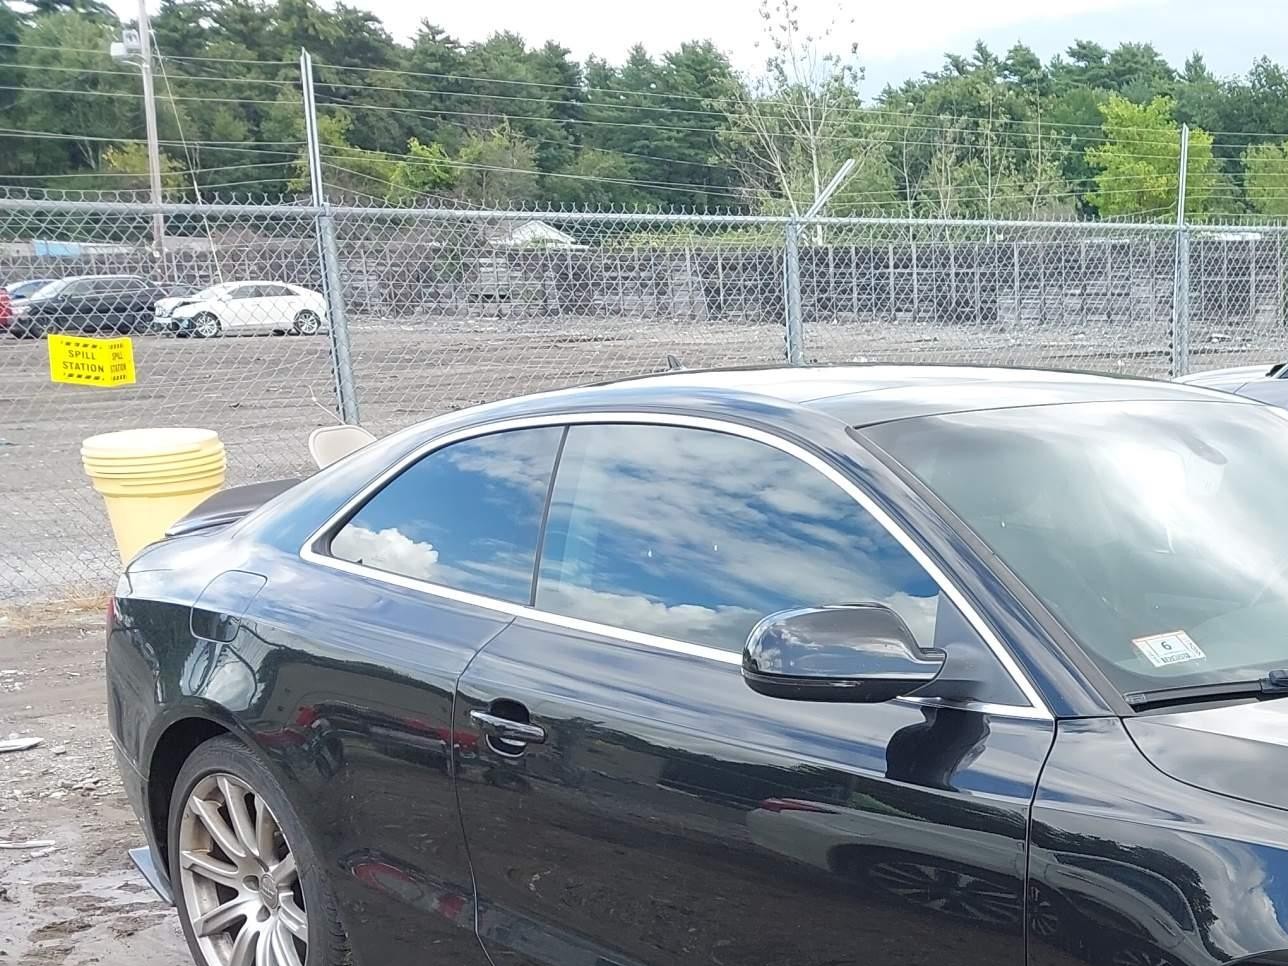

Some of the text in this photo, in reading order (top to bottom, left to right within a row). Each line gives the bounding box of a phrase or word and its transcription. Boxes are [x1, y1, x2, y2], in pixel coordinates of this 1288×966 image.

[68, 349, 96, 360] SPILL
[62, 361, 104, 373] STATION
[1161, 640, 1173, 651] 6
